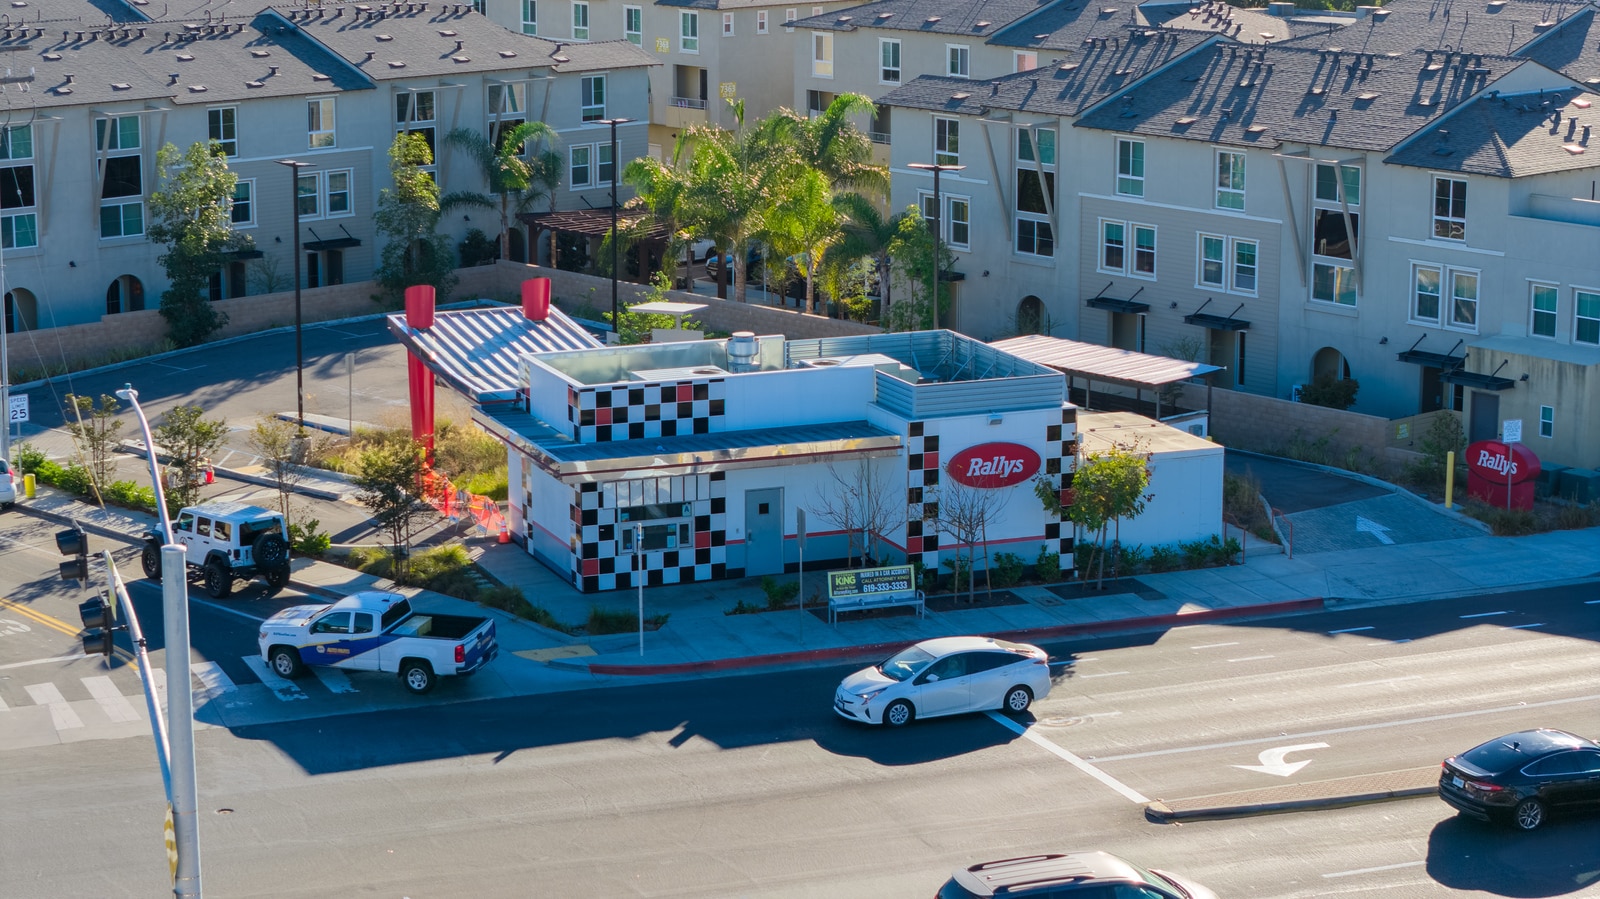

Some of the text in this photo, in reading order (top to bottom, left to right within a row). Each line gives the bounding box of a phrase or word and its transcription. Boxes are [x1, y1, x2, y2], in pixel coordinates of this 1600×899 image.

[11, 408, 27, 420] 25
[966, 456, 1024, 478] Rallys
[1477, 449, 1518, 476] Rallys
[835, 576, 856, 586] KING
[863, 581, 907, 592] 619-333-3333
